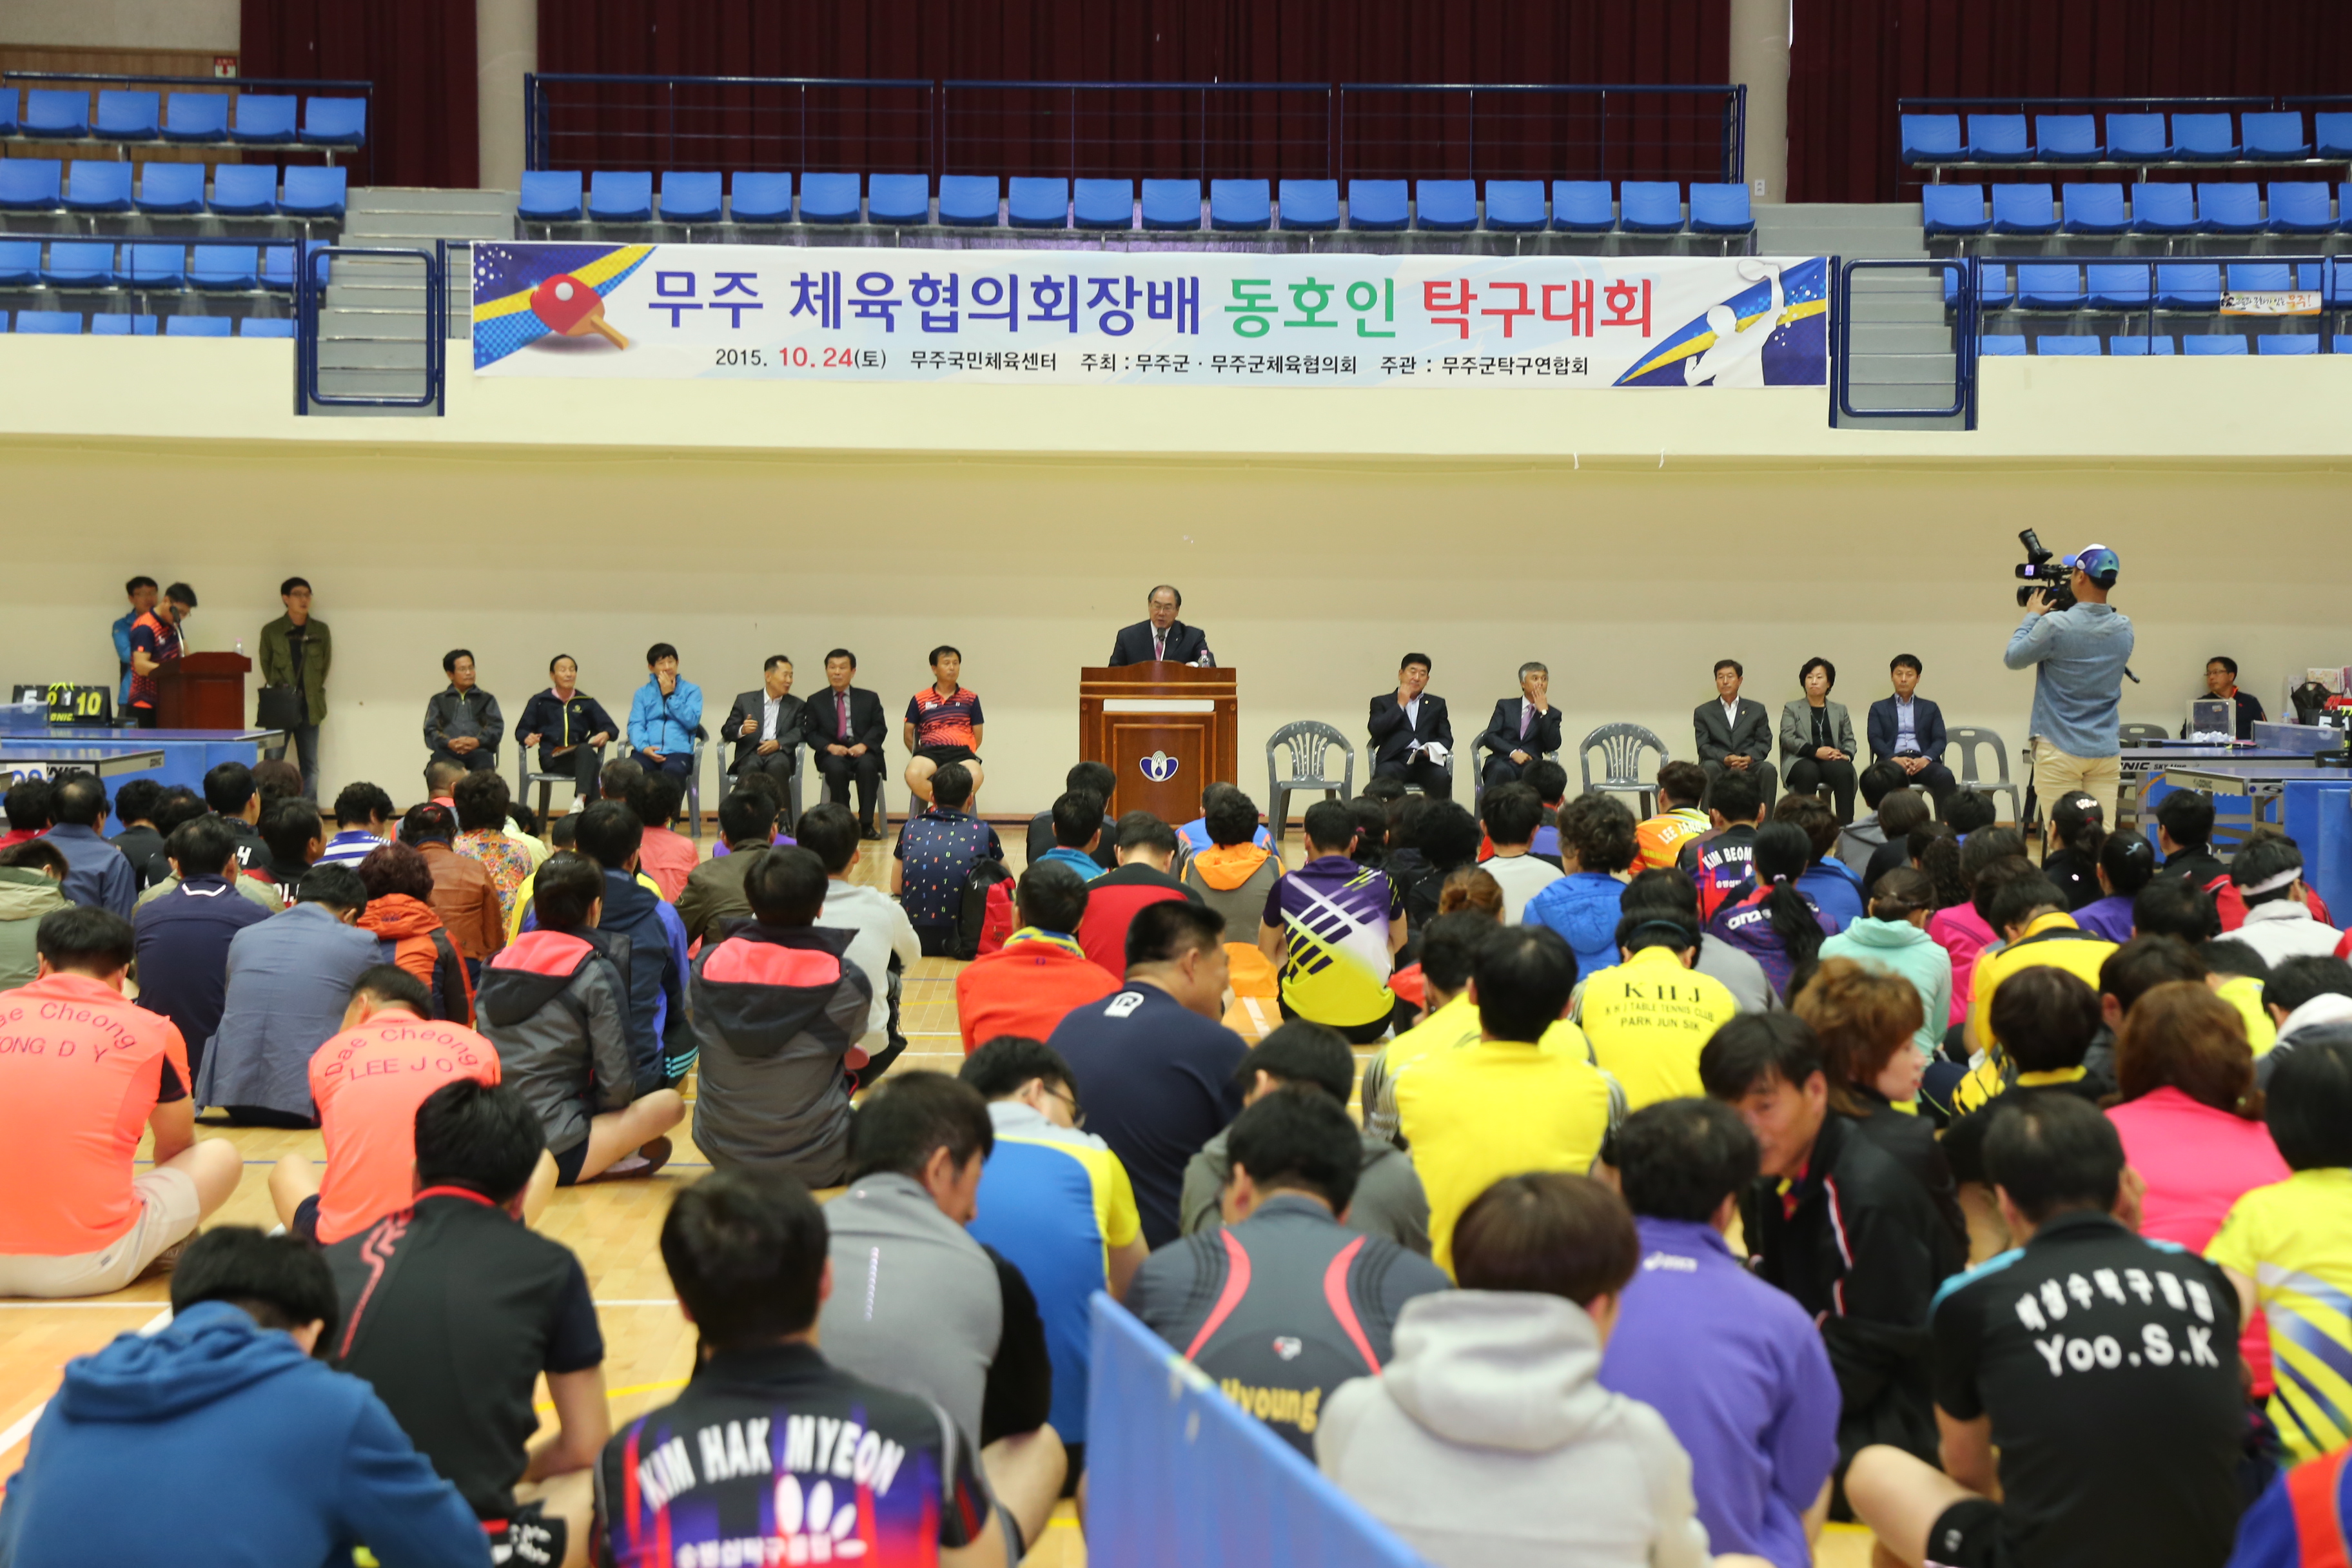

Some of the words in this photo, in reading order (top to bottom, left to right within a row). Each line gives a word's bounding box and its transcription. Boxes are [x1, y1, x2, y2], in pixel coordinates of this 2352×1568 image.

[649, 271, 763, 329] 무주
[789, 271, 1199, 336] 체육협의회장배
[1224, 277, 1396, 338] 동호인
[1422, 278, 1652, 340] 탁구대회
[716, 349, 767, 366] 2015.
[910, 351, 1056, 371] 무주국민체육센터
[1081, 353, 1115, 372] 주최
[1135, 355, 1190, 373] 무주군
[1211, 355, 1356, 375] 무주군체육협의회
[1380, 356, 1417, 375] 주관
[1442, 357, 1588, 375] 무주군탁구연합회
[22, 690, 37, 714] 5
[64, 691, 72, 706] 1
[77, 692, 101, 716] 10
[2318, 716, 2333, 740] 5
[1658, 825, 1678, 844] LEE
[1701, 850, 1723, 870] KIM
[1723, 846, 1752, 863] BEOM
[1625, 982, 1644, 998] K
[1658, 985, 1677, 1001] H
[1688, 987, 1700, 1003] J
[1631, 1002, 1656, 1012] TABLE
[1661, 1004, 1691, 1015] TENNIS
[40, 1002, 137, 1050] Cheong
[1620, 1016, 1652, 1028] PARK
[1657, 1017, 1678, 1028] JUN
[0, 1036, 46, 1055] ONG
[59, 1040, 76, 1057] D
[93, 1044, 109, 1063] Y
[325, 1037, 368, 1077] Dae
[380, 1027, 478, 1066] Cheong
[350, 1057, 400, 1081] LEE
[410, 1056, 427, 1072] J
[634, 1436, 697, 1514] KIM
[697, 1416, 773, 1484] HAK
[782, 1414, 906, 1499] MYEON
